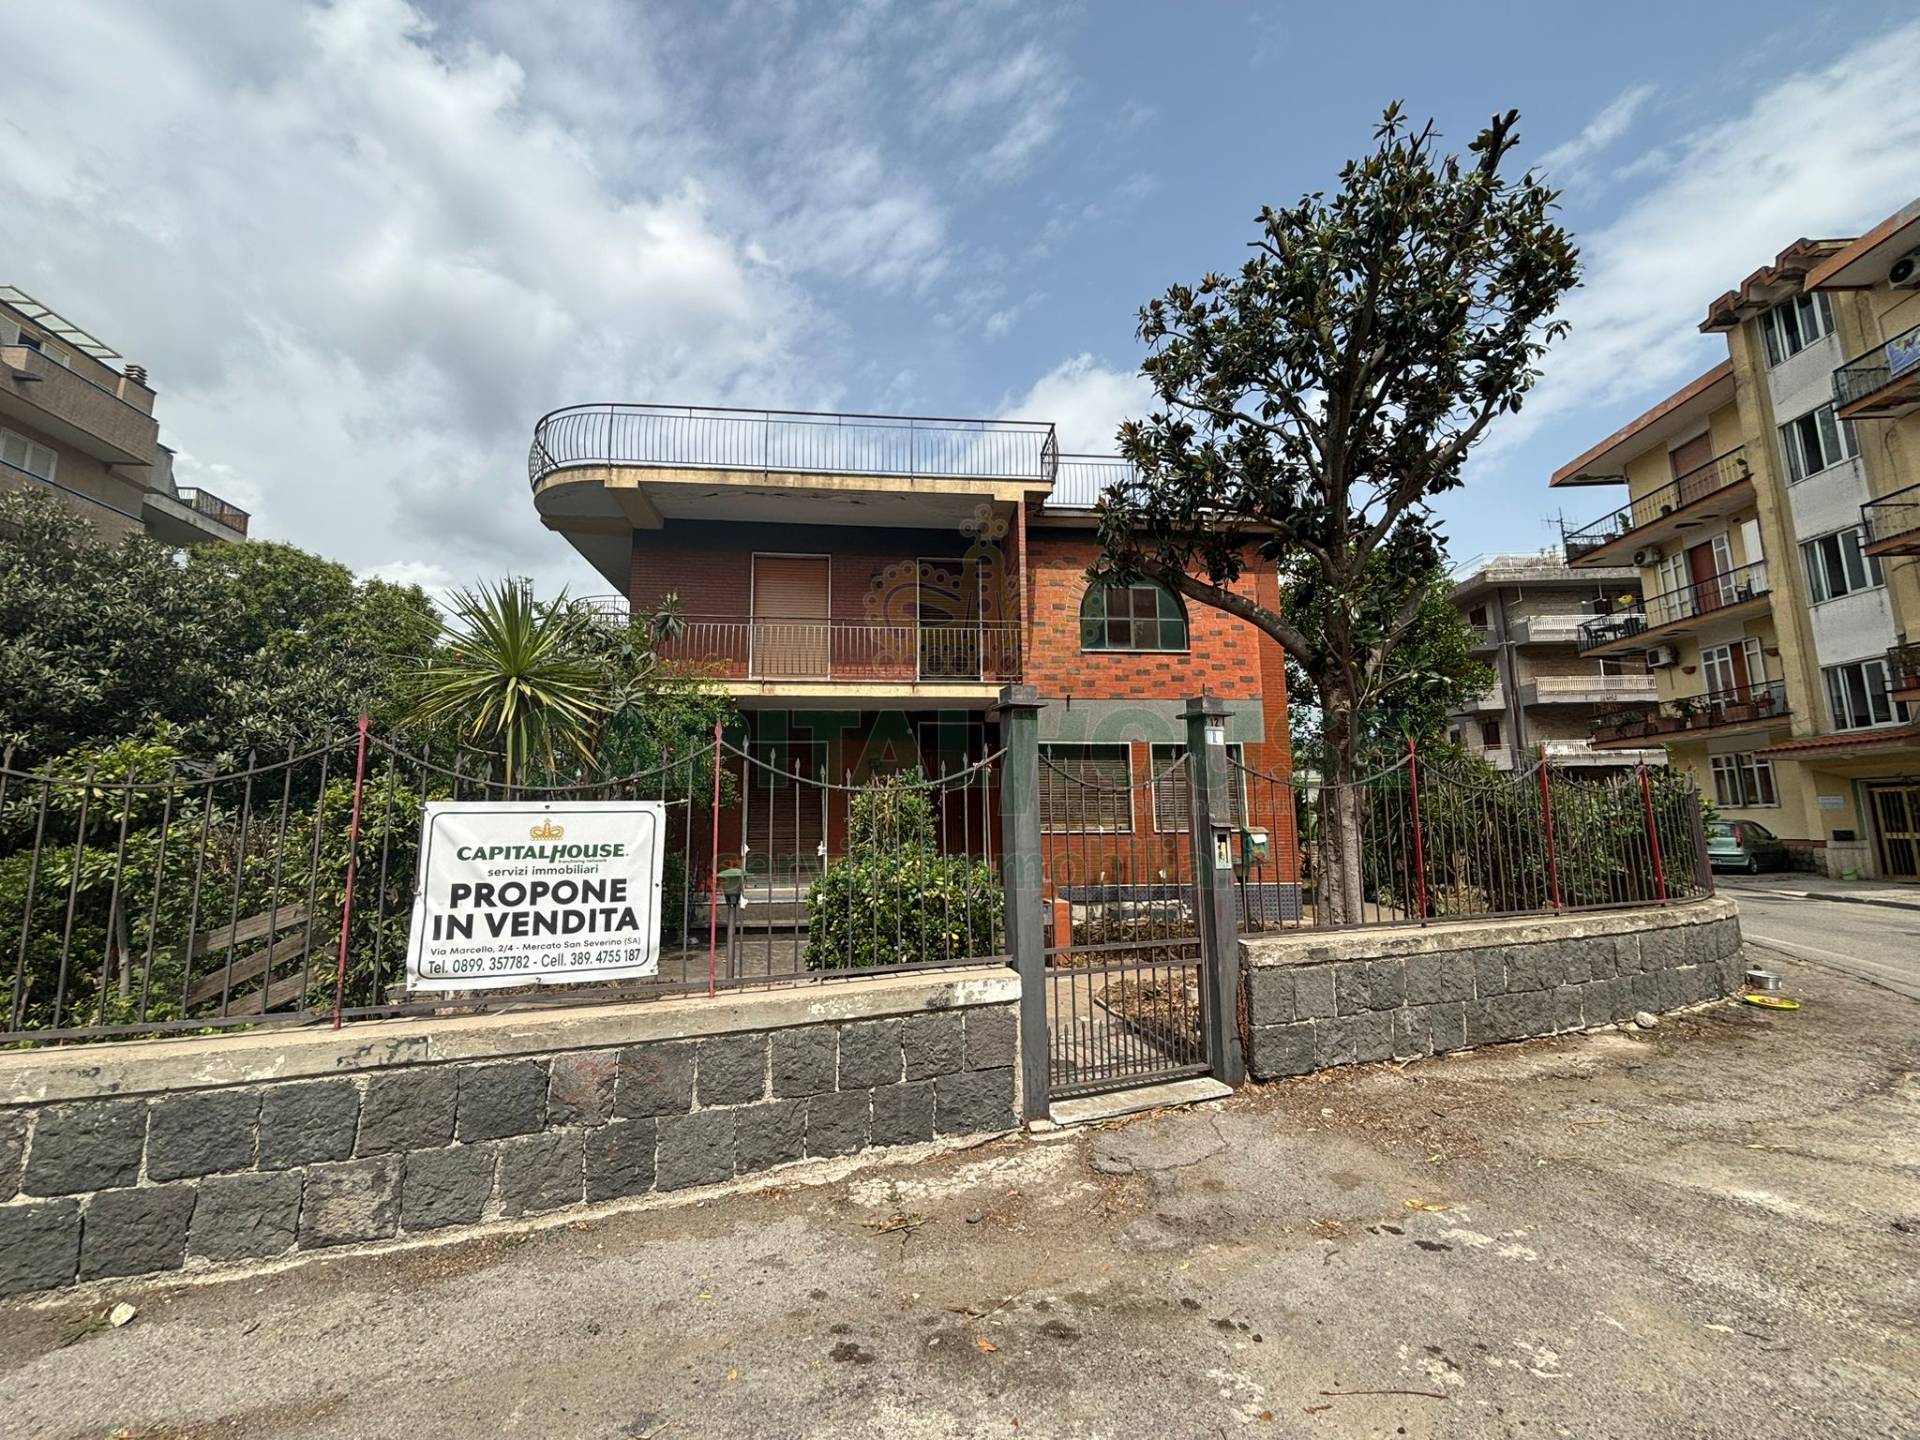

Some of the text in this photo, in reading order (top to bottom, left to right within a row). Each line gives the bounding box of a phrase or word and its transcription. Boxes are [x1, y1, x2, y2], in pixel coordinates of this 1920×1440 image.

[487, 864, 599, 877] servizi immobiliari
[449, 878, 628, 909] PROPONE
[432, 906, 640, 941] IN VENDITA
[430, 948, 447, 956] Via
[449, 945, 496, 955] Marcello,
[498, 944, 514, 953] 2/4
[522, 942, 562, 951] Mercato
[563, 940, 582, 949] San
[583, 939, 622, 948] Severino
[624, 937, 641, 946] (SA)
[428, 960, 449, 974] Tel.
[452, 957, 485, 973] 0899.
[488, 954, 530, 971] 357782
[541, 953, 567, 968] Cell.
[570, 951, 593, 966] 389.
[595, 948, 621, 964] 4755
[623, 948, 641, 962] 187
